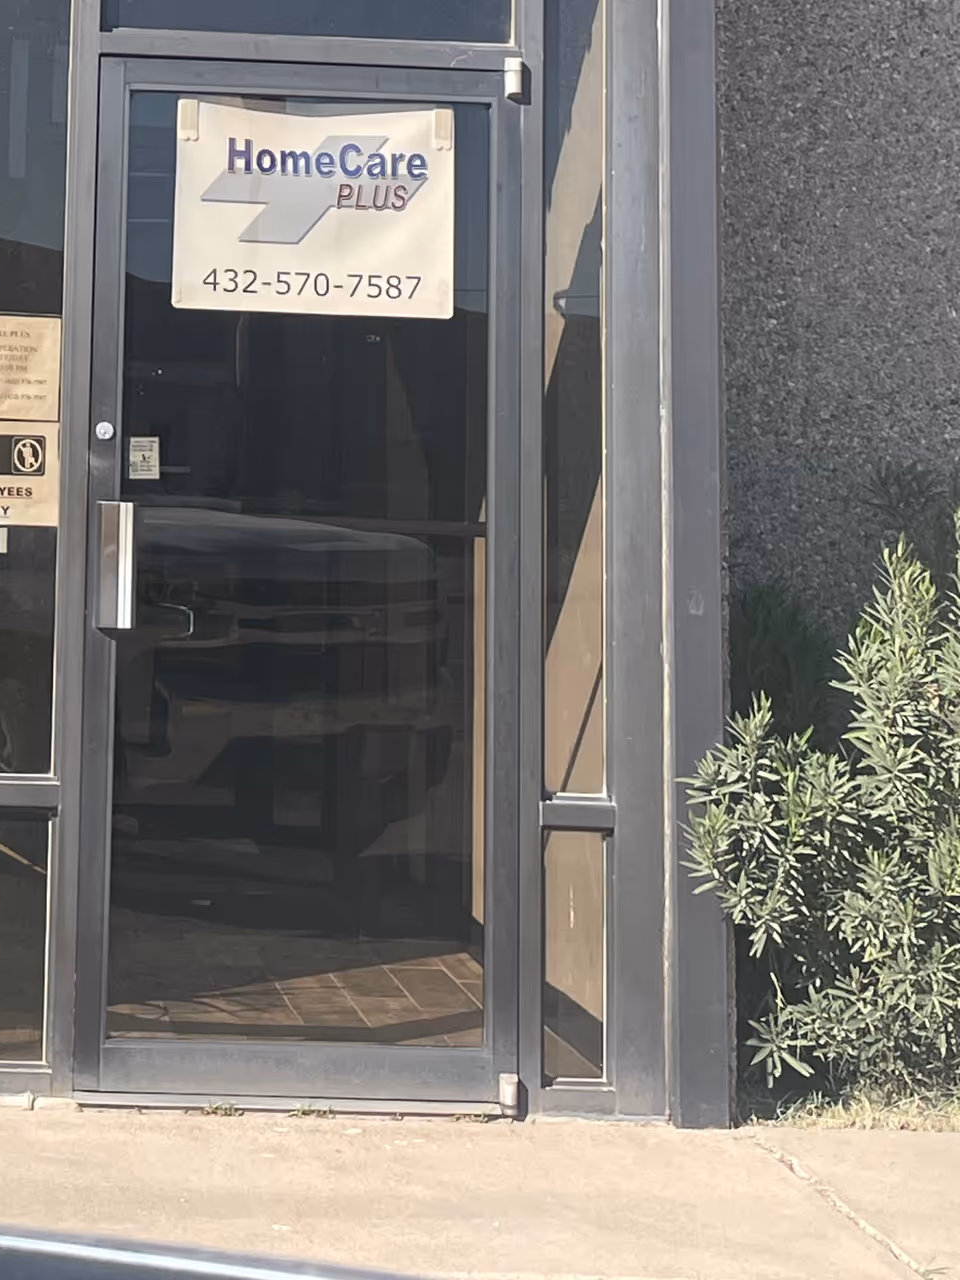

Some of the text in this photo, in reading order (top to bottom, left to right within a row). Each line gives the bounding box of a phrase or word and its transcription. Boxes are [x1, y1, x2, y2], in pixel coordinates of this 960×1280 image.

[227, 137, 429, 180] HomeCare
[336, 184, 408, 211] PLUS
[202, 268, 422, 300] 432-570-7587
